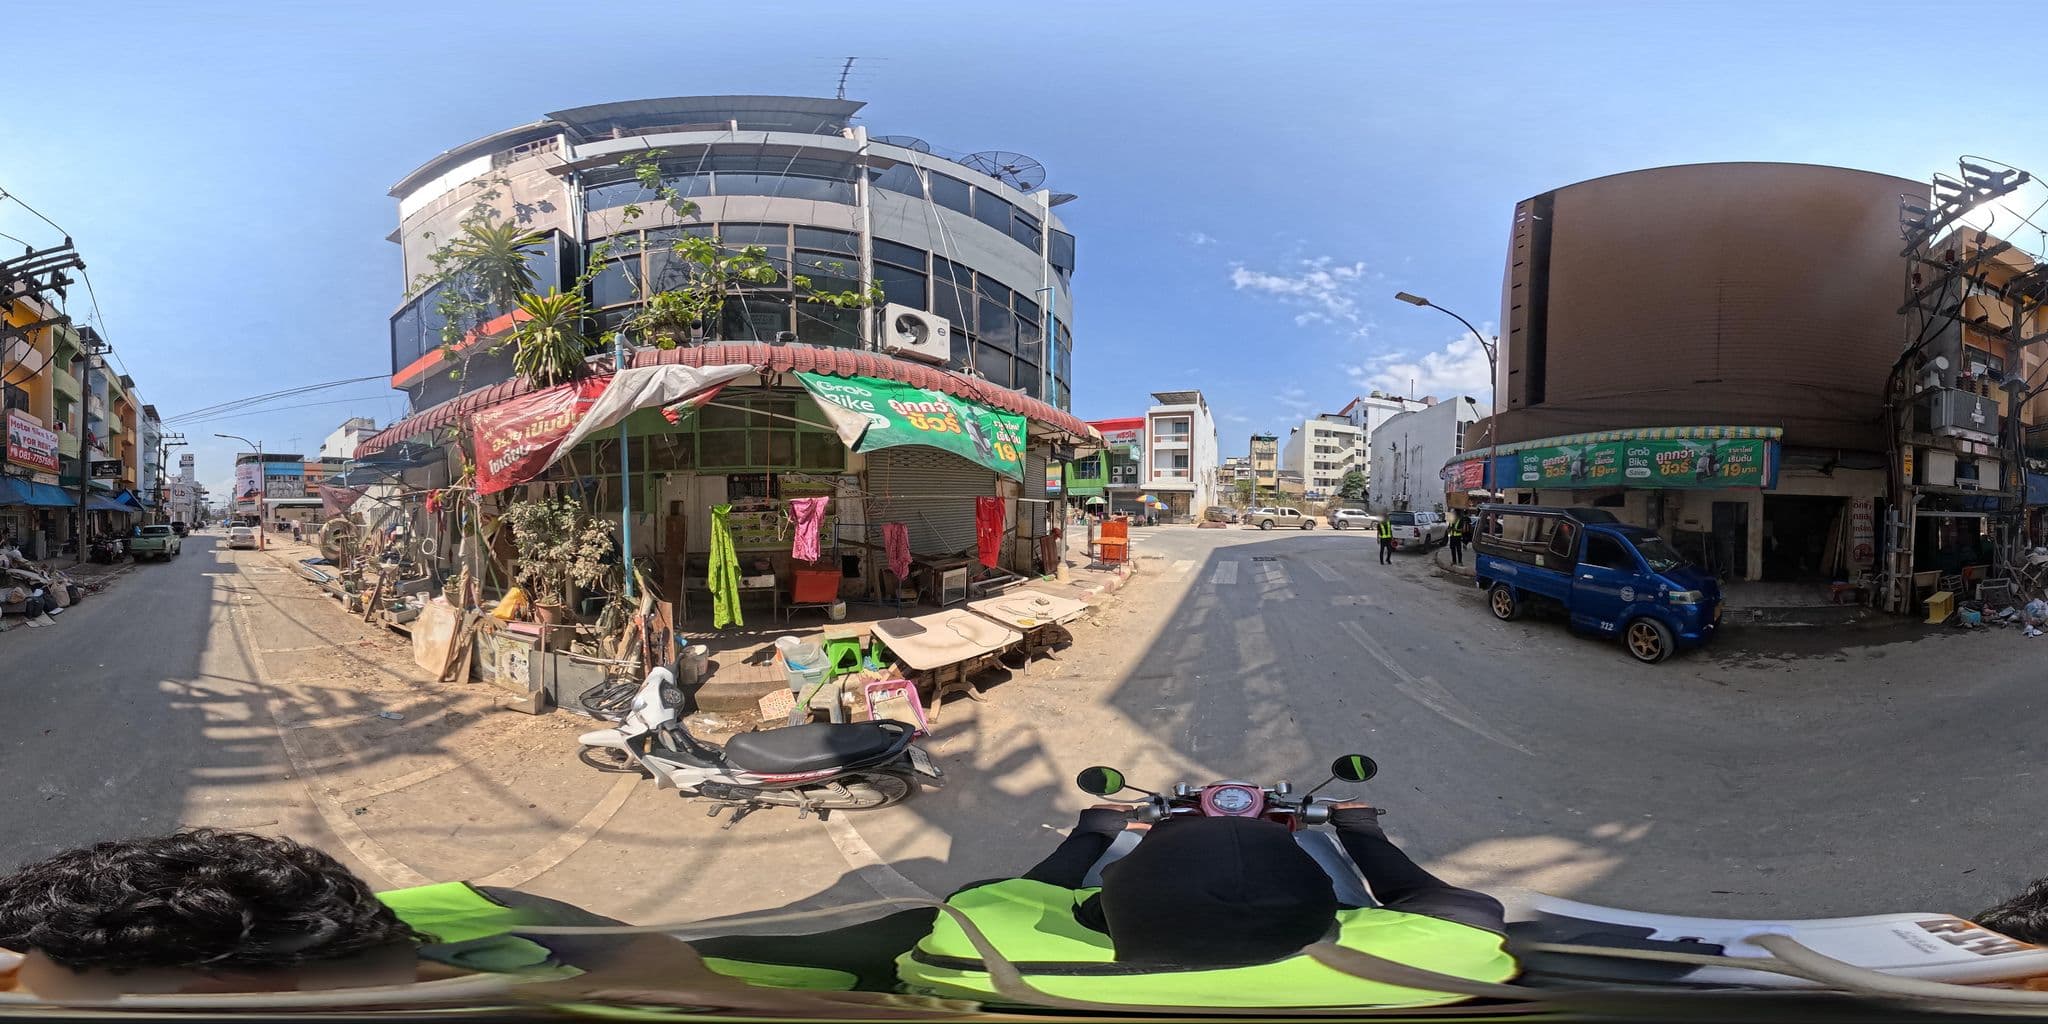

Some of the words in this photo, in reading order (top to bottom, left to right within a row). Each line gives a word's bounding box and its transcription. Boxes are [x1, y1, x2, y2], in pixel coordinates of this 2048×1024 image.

[816, 381, 872, 397] Grab
[1627, 447, 1650, 457] Grab
[1629, 457, 1648, 467] Bike
[1722, 464, 1740, 477] 19
